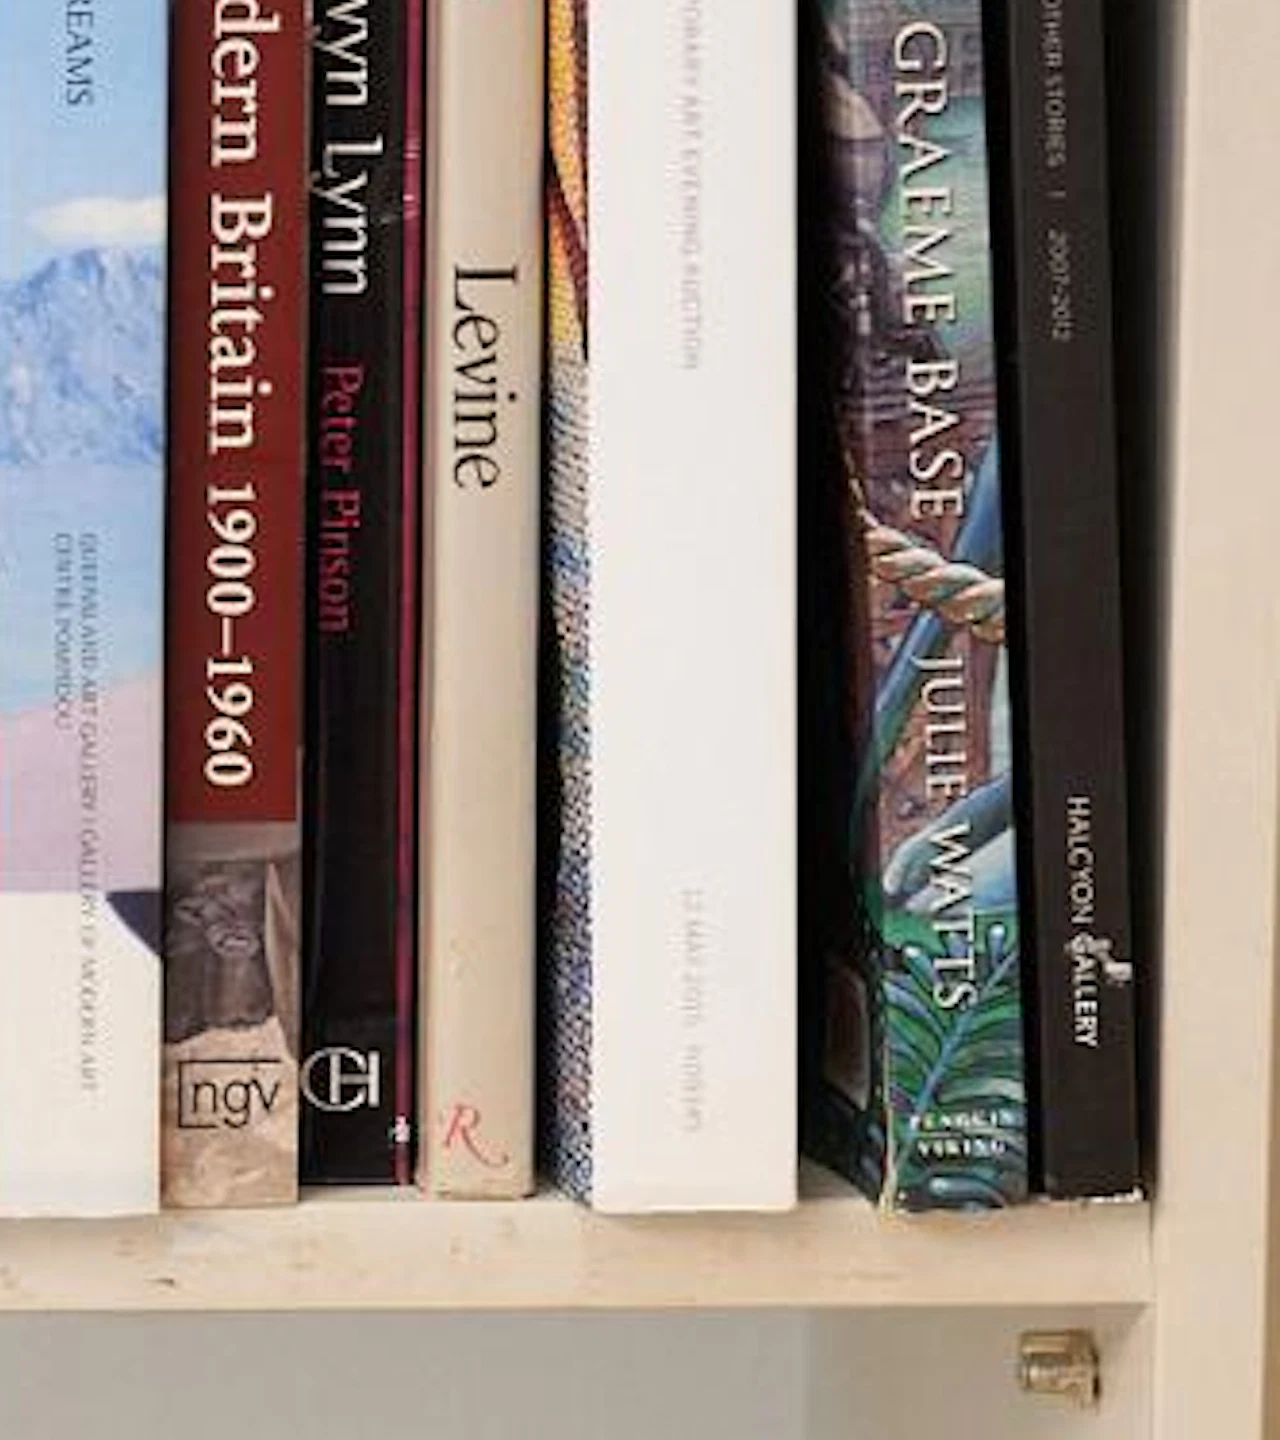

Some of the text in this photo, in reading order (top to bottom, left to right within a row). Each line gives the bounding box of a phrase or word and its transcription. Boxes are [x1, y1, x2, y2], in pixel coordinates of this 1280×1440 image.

[310, 133, 384, 295] Lynn
[894, 21, 958, 327] GRAEME
[209, 191, 275, 456] Britain
[321, 364, 364, 473] Peter
[452, 264, 519, 489] Levine
[907, 359, 964, 520] BASE
[914, 655, 980, 1011] JULIE WATTS
[1066, 795, 1102, 1048] HALCYON GALLERY
[192, 1076, 280, 1129] ngv
